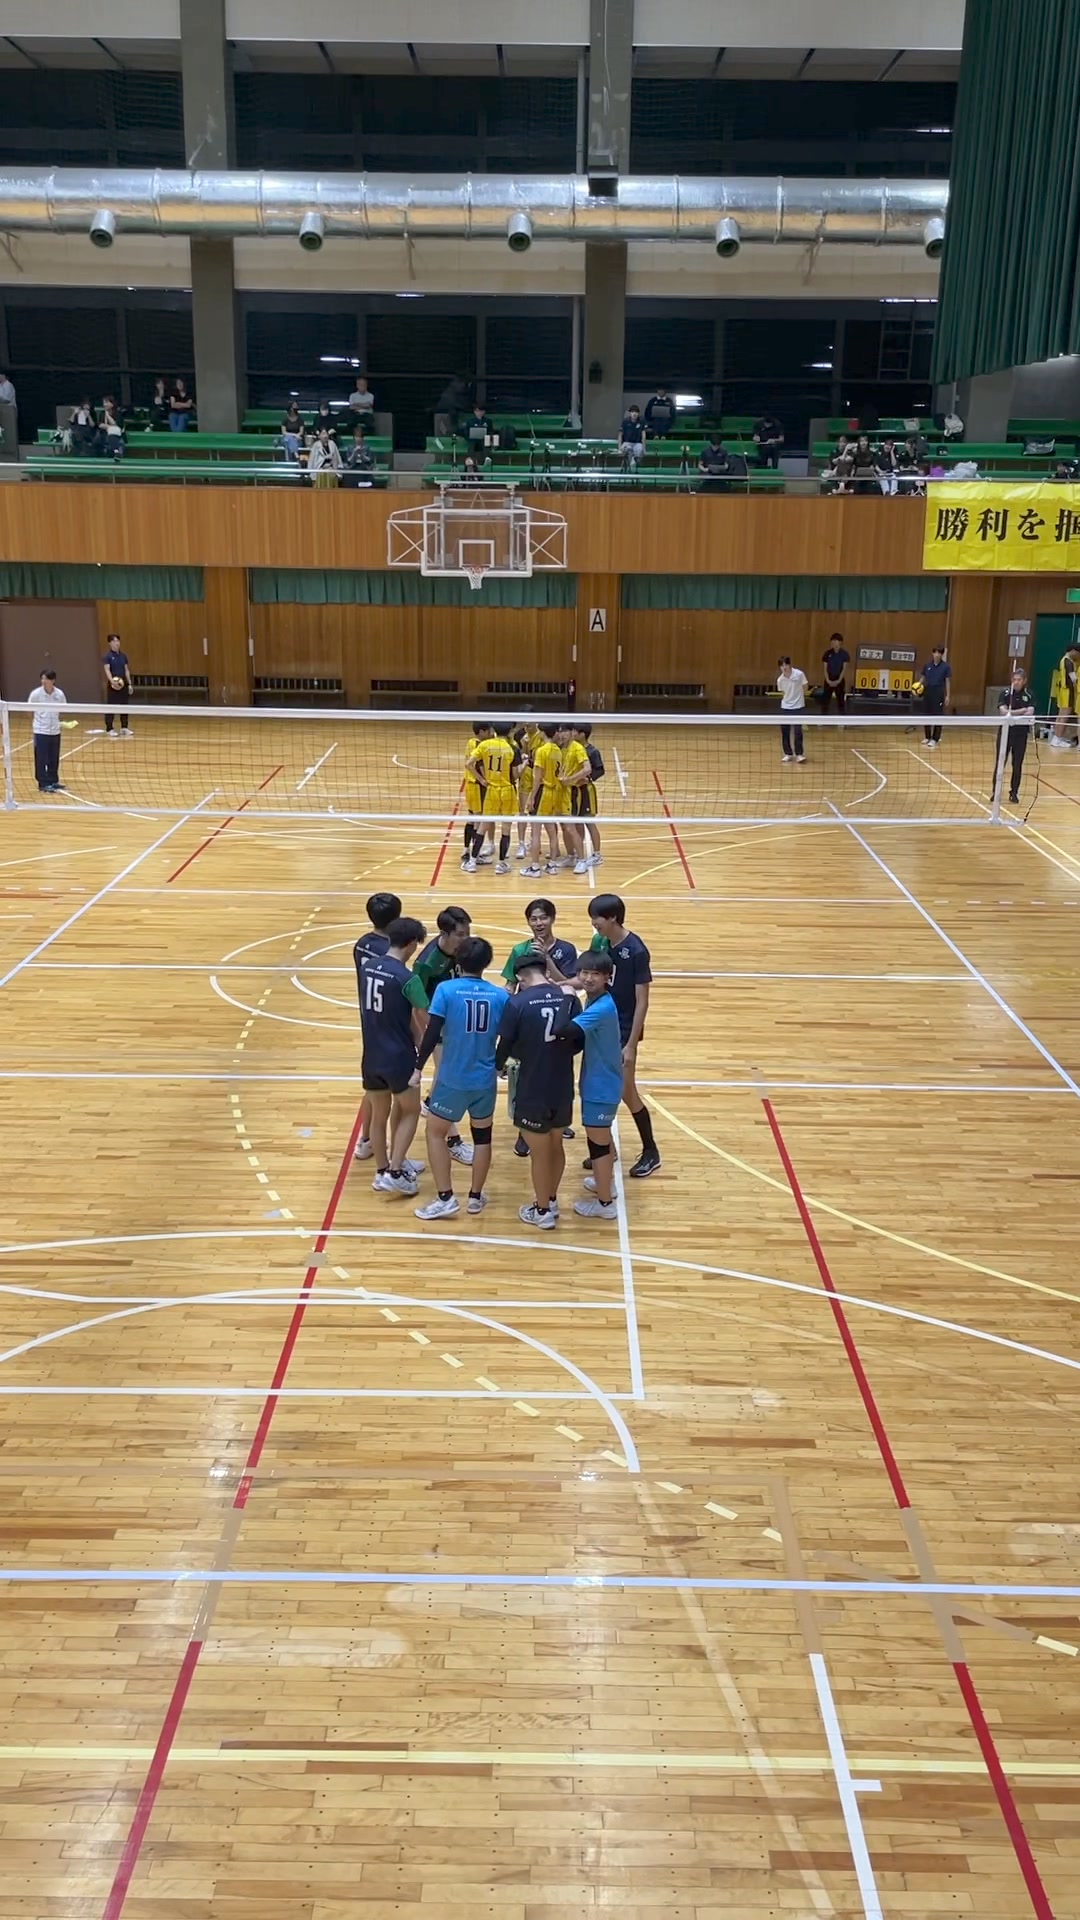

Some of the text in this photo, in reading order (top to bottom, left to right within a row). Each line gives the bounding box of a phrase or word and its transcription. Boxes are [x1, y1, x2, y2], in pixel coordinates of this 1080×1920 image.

[591, 609, 604, 630] A
[488, 755, 503, 773] 11
[366, 976, 385, 1013] 15
[463, 998, 491, 1033] 10
